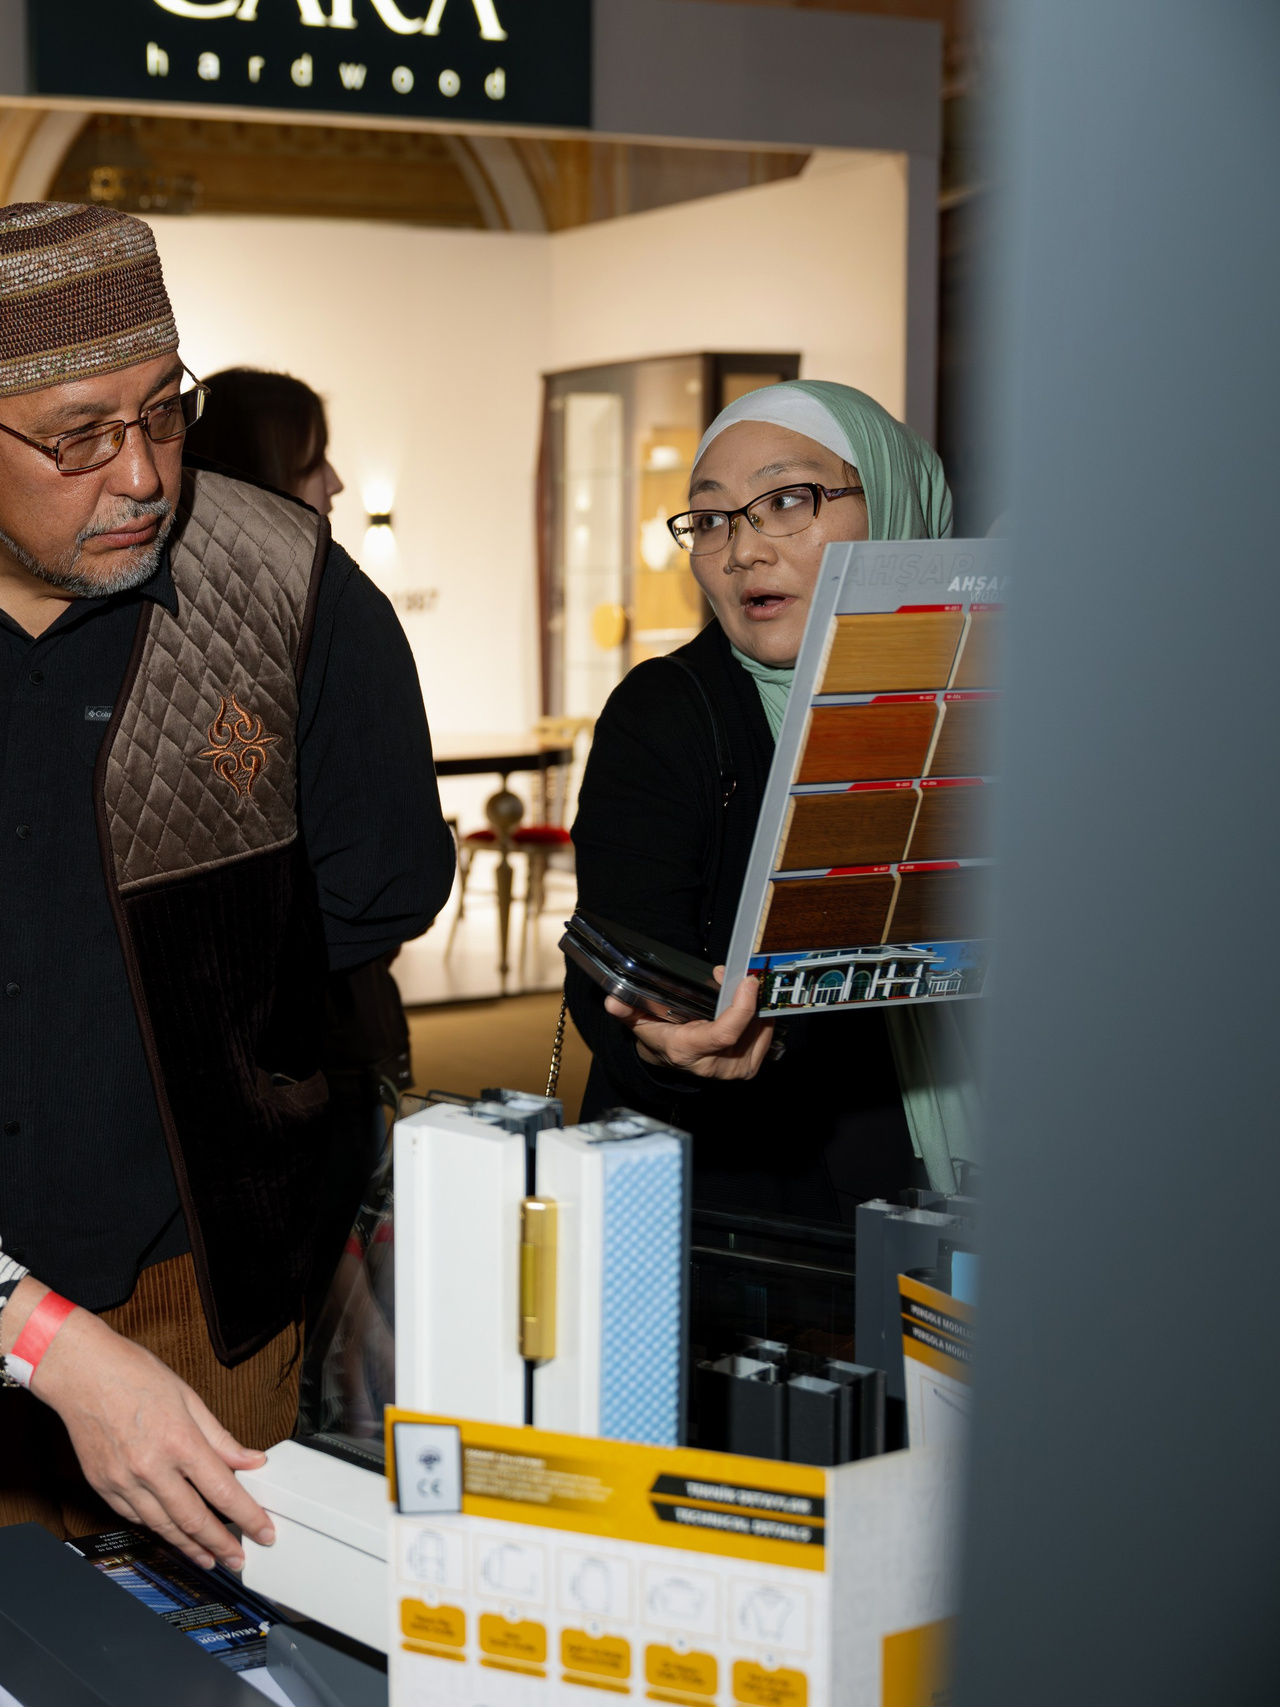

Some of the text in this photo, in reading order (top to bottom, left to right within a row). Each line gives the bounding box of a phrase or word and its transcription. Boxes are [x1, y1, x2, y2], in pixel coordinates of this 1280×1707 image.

[146, 41, 506, 101] hardwood
[674, 1506, 813, 1543] TECHNICAL DETAILS
[198, 1627, 258, 1644] SELVADOR
